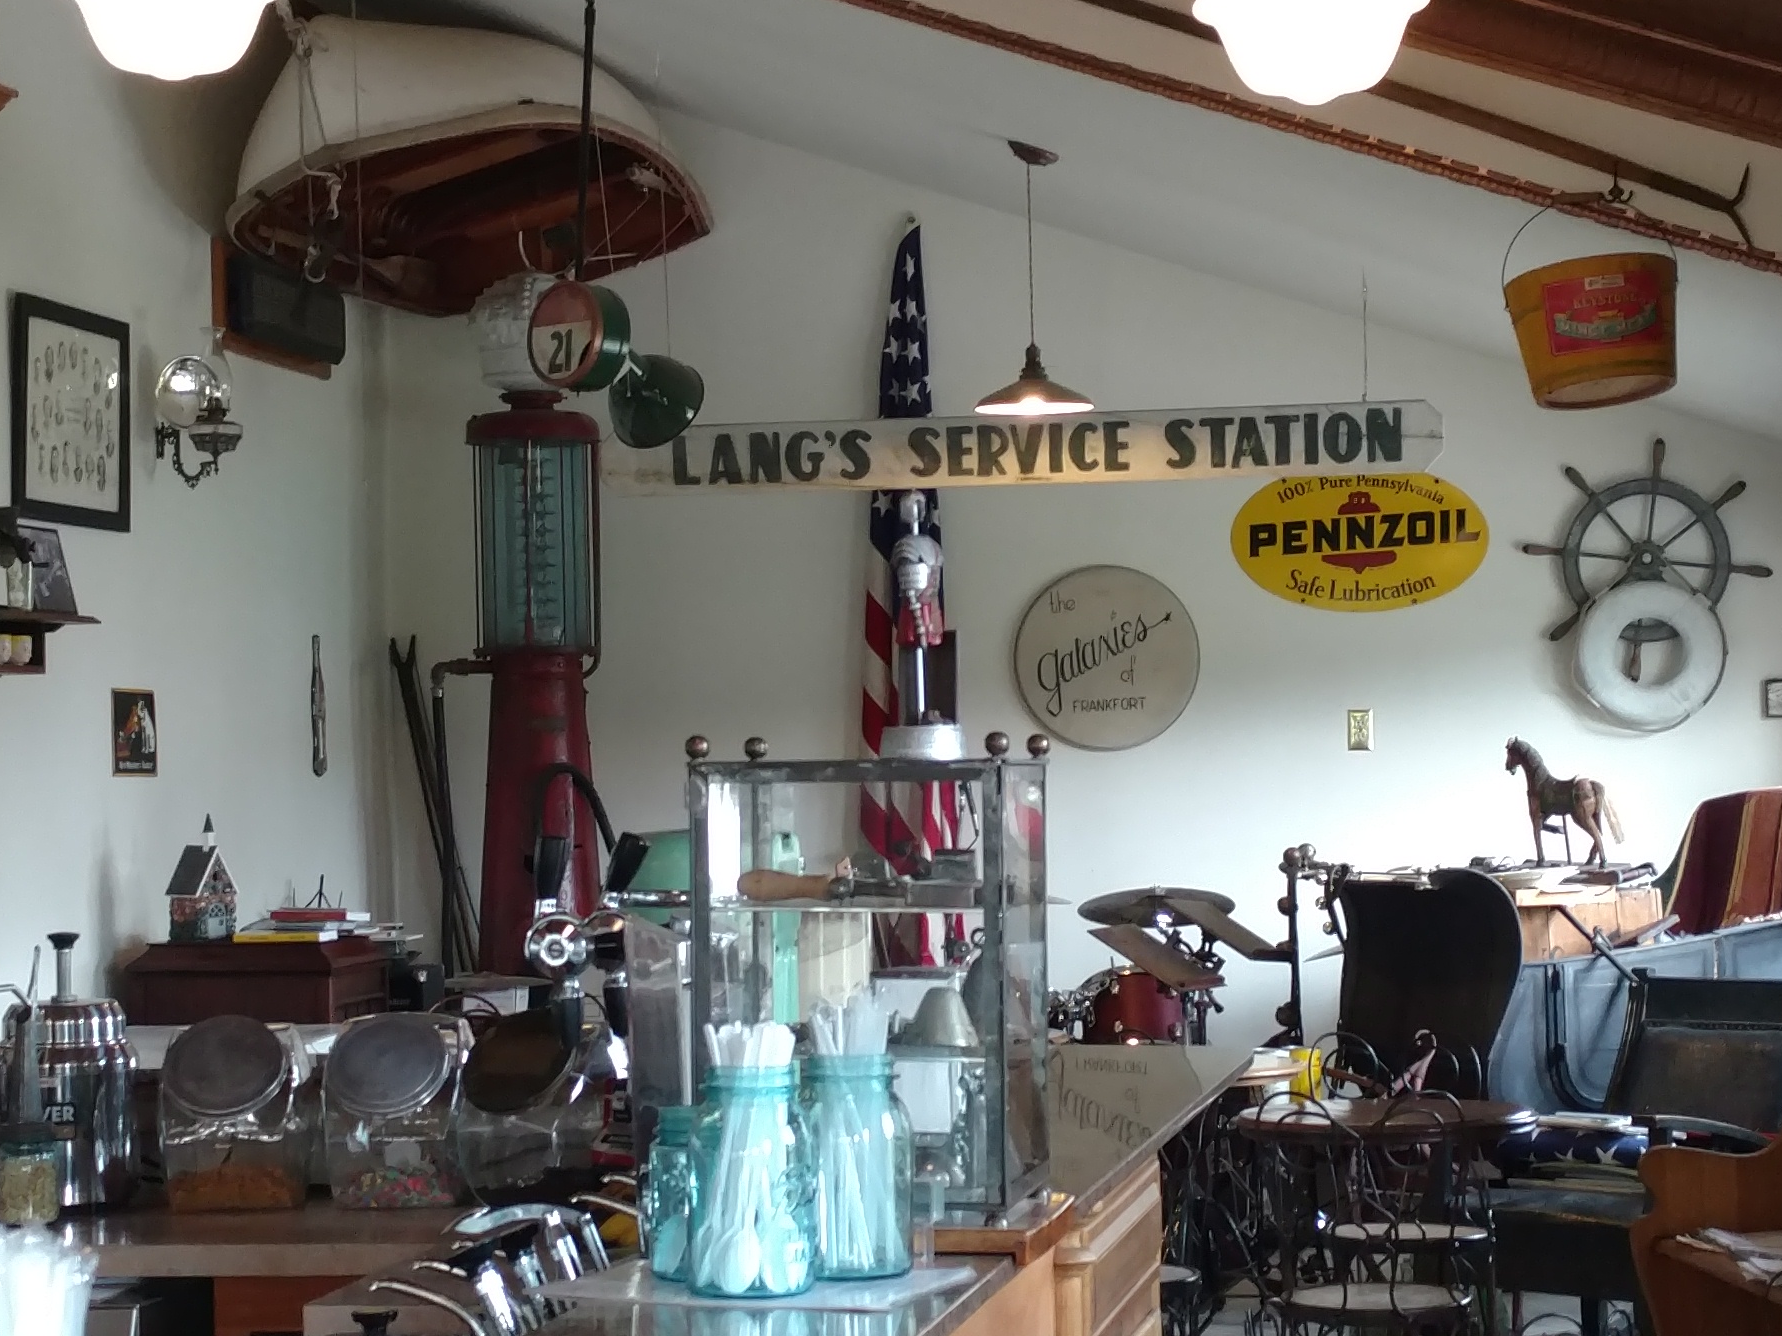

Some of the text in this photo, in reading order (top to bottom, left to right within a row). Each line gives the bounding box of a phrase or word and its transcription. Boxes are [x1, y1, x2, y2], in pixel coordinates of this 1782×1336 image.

[548, 328, 573, 375] 21
[671, 407, 1403, 487] LANG'S SERVICE STATION
[1277, 473, 1445, 505] 100% Pure Pennsylvania
[1248, 508, 1482, 559] PENNZOIL
[1049, 589, 1077, 614] the
[1285, 569, 1437, 603] Safe Lubrication
[1119, 654, 1137, 686] of
[1072, 695, 1147, 714] FRANKFORT
